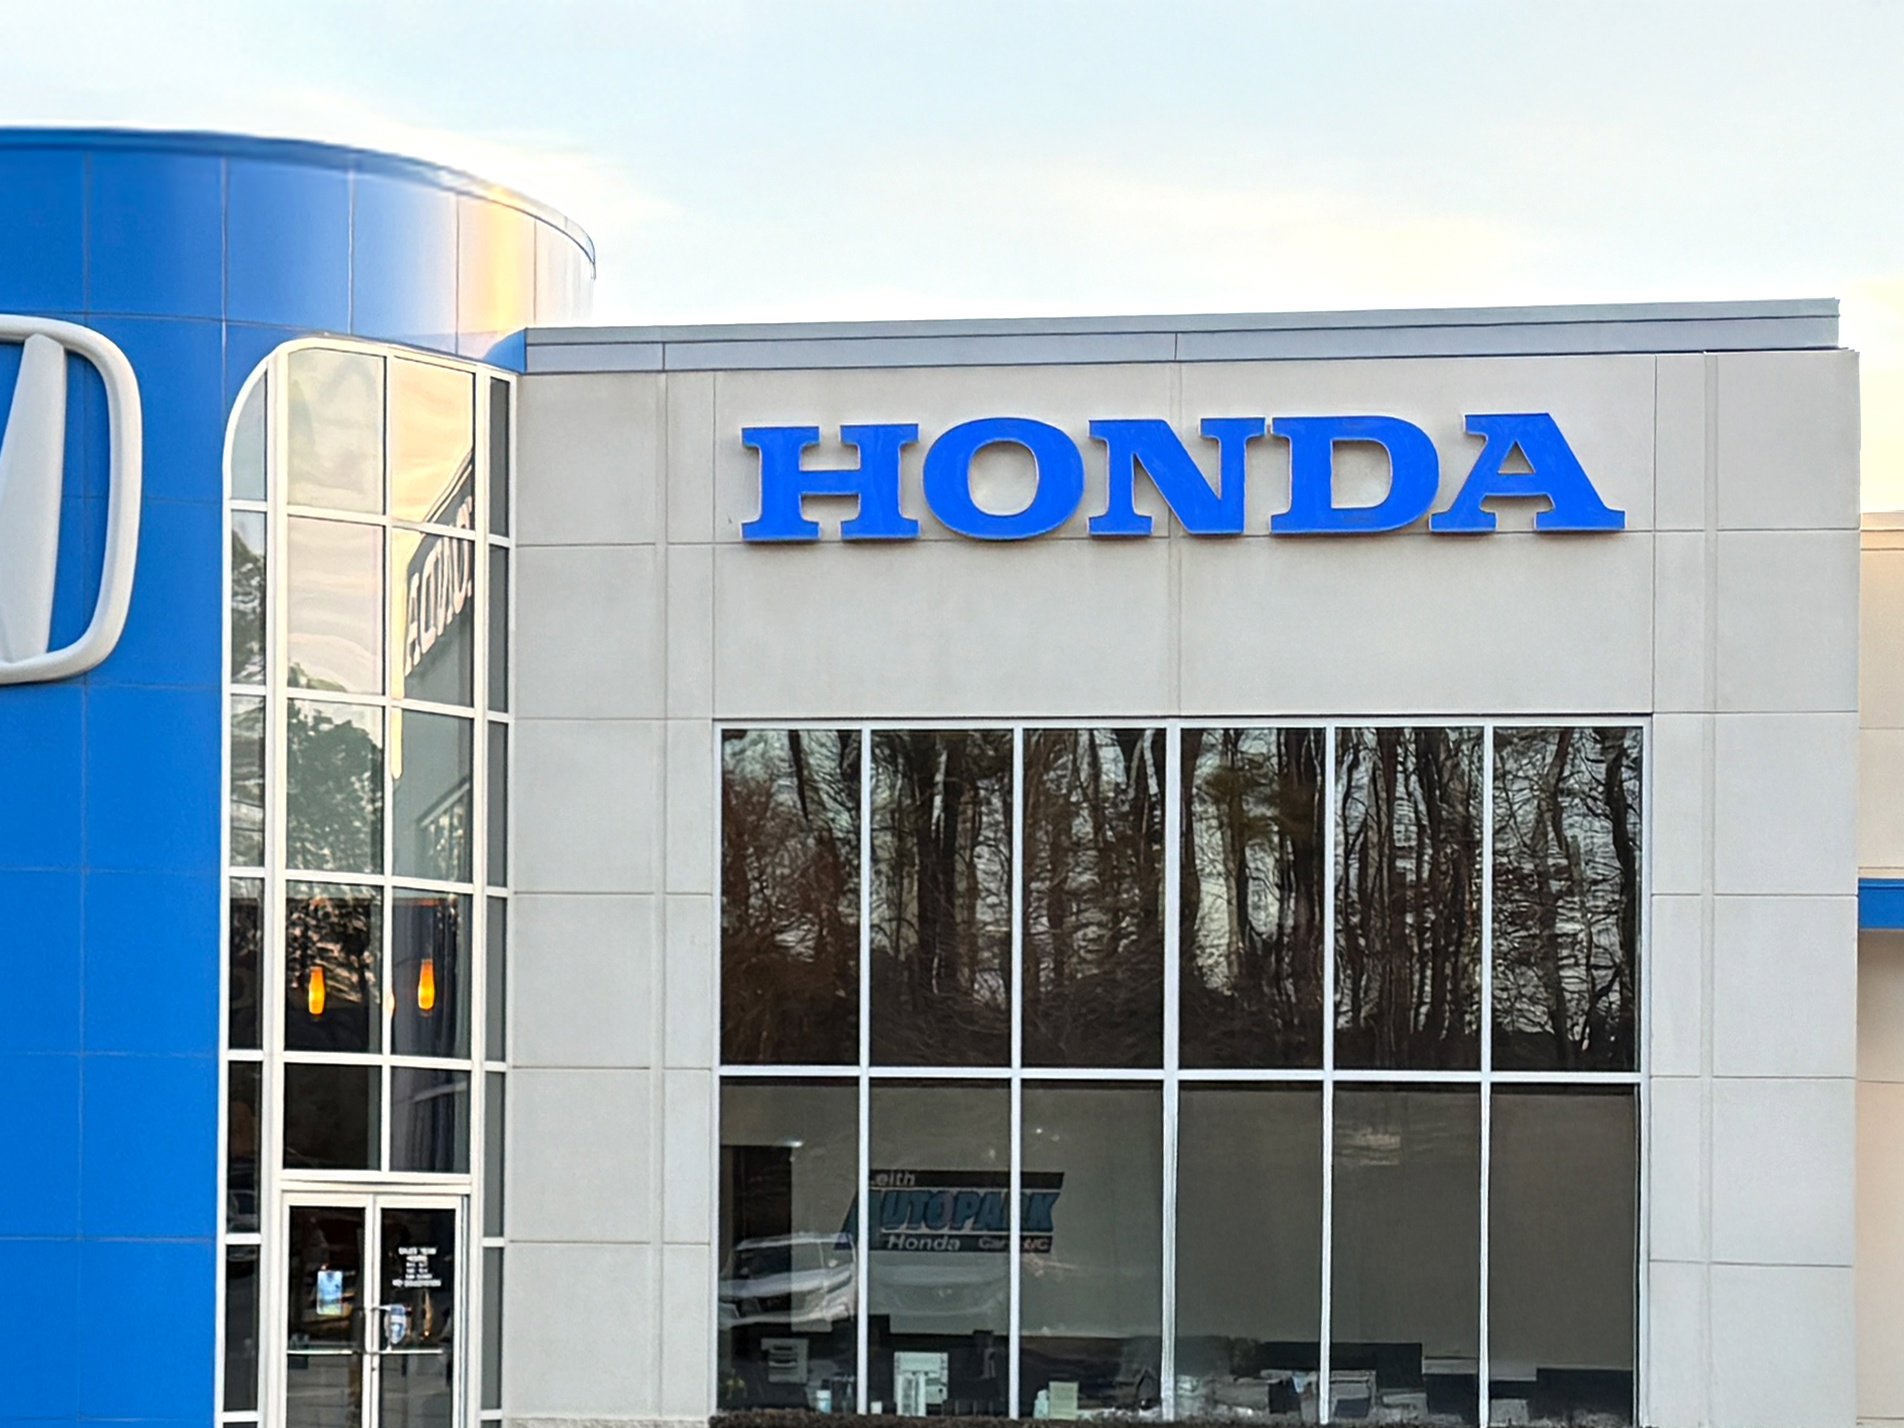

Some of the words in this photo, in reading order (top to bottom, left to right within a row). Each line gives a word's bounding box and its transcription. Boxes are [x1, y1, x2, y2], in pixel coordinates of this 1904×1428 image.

[742, 412, 1626, 542] HONDA
[869, 1170, 916, 1187] eith
[887, 1234, 961, 1251] Honda
